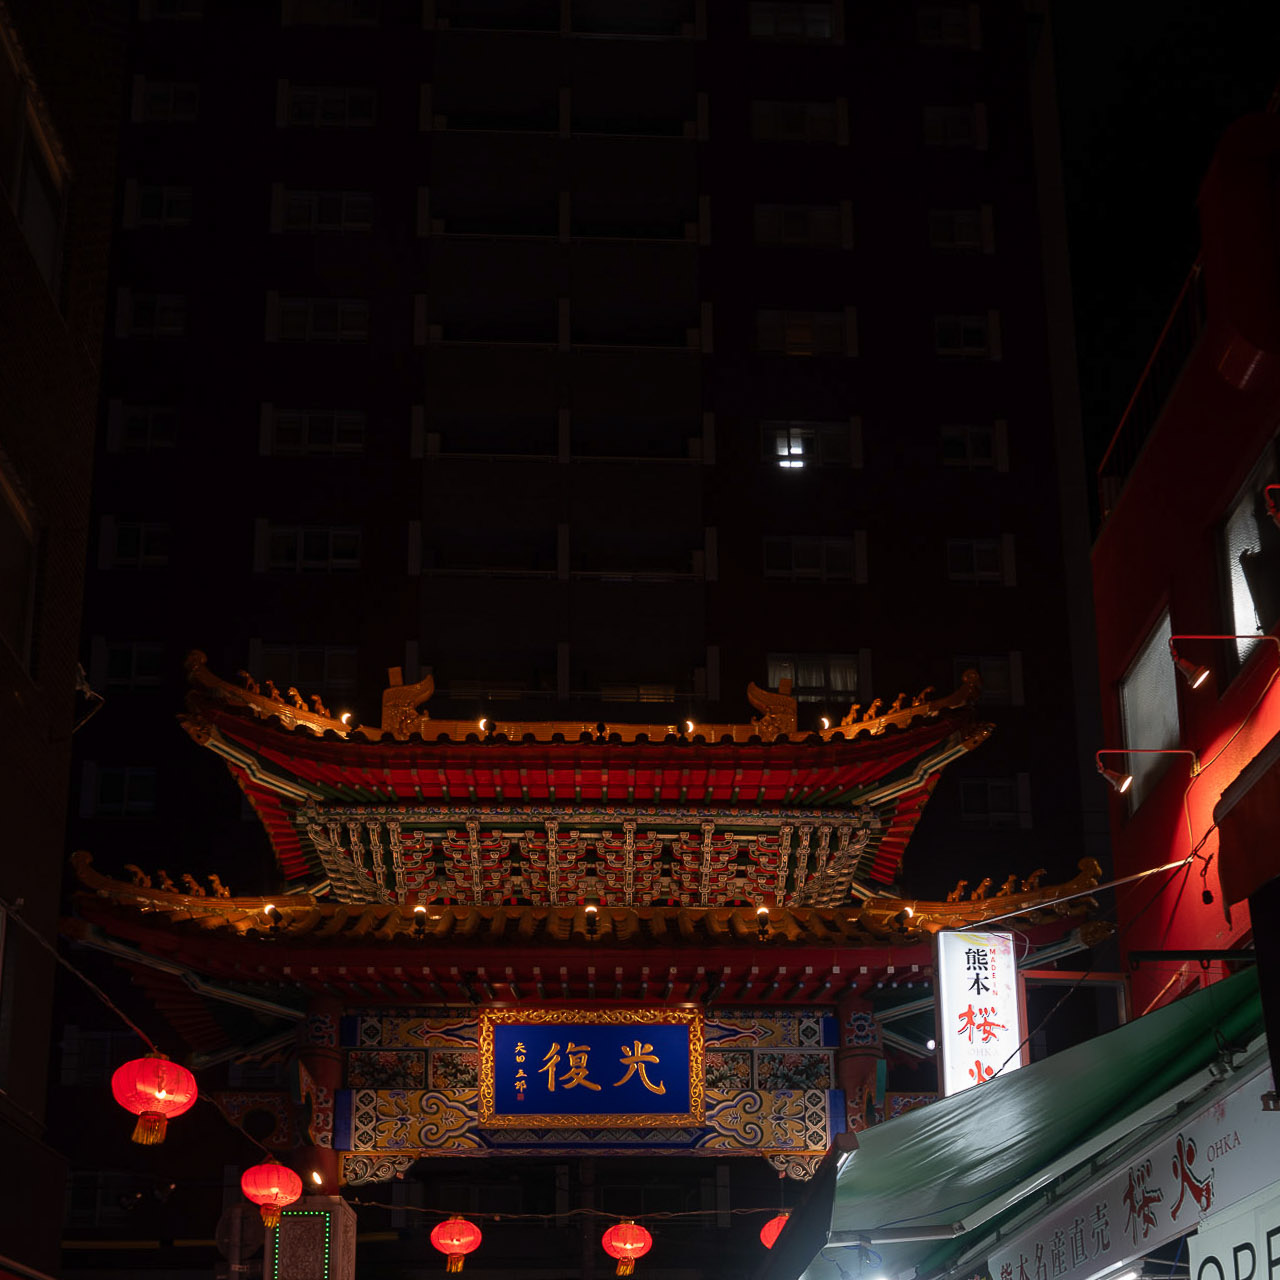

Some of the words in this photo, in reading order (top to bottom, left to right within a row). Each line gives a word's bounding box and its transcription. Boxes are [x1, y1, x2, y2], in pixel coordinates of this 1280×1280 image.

[964, 948, 991, 996] 熊本
[989, 948, 997, 979] MADE
[1206, 1130, 1242, 1164] OHKA
[1123, 1132, 1216, 1247] 桜火
